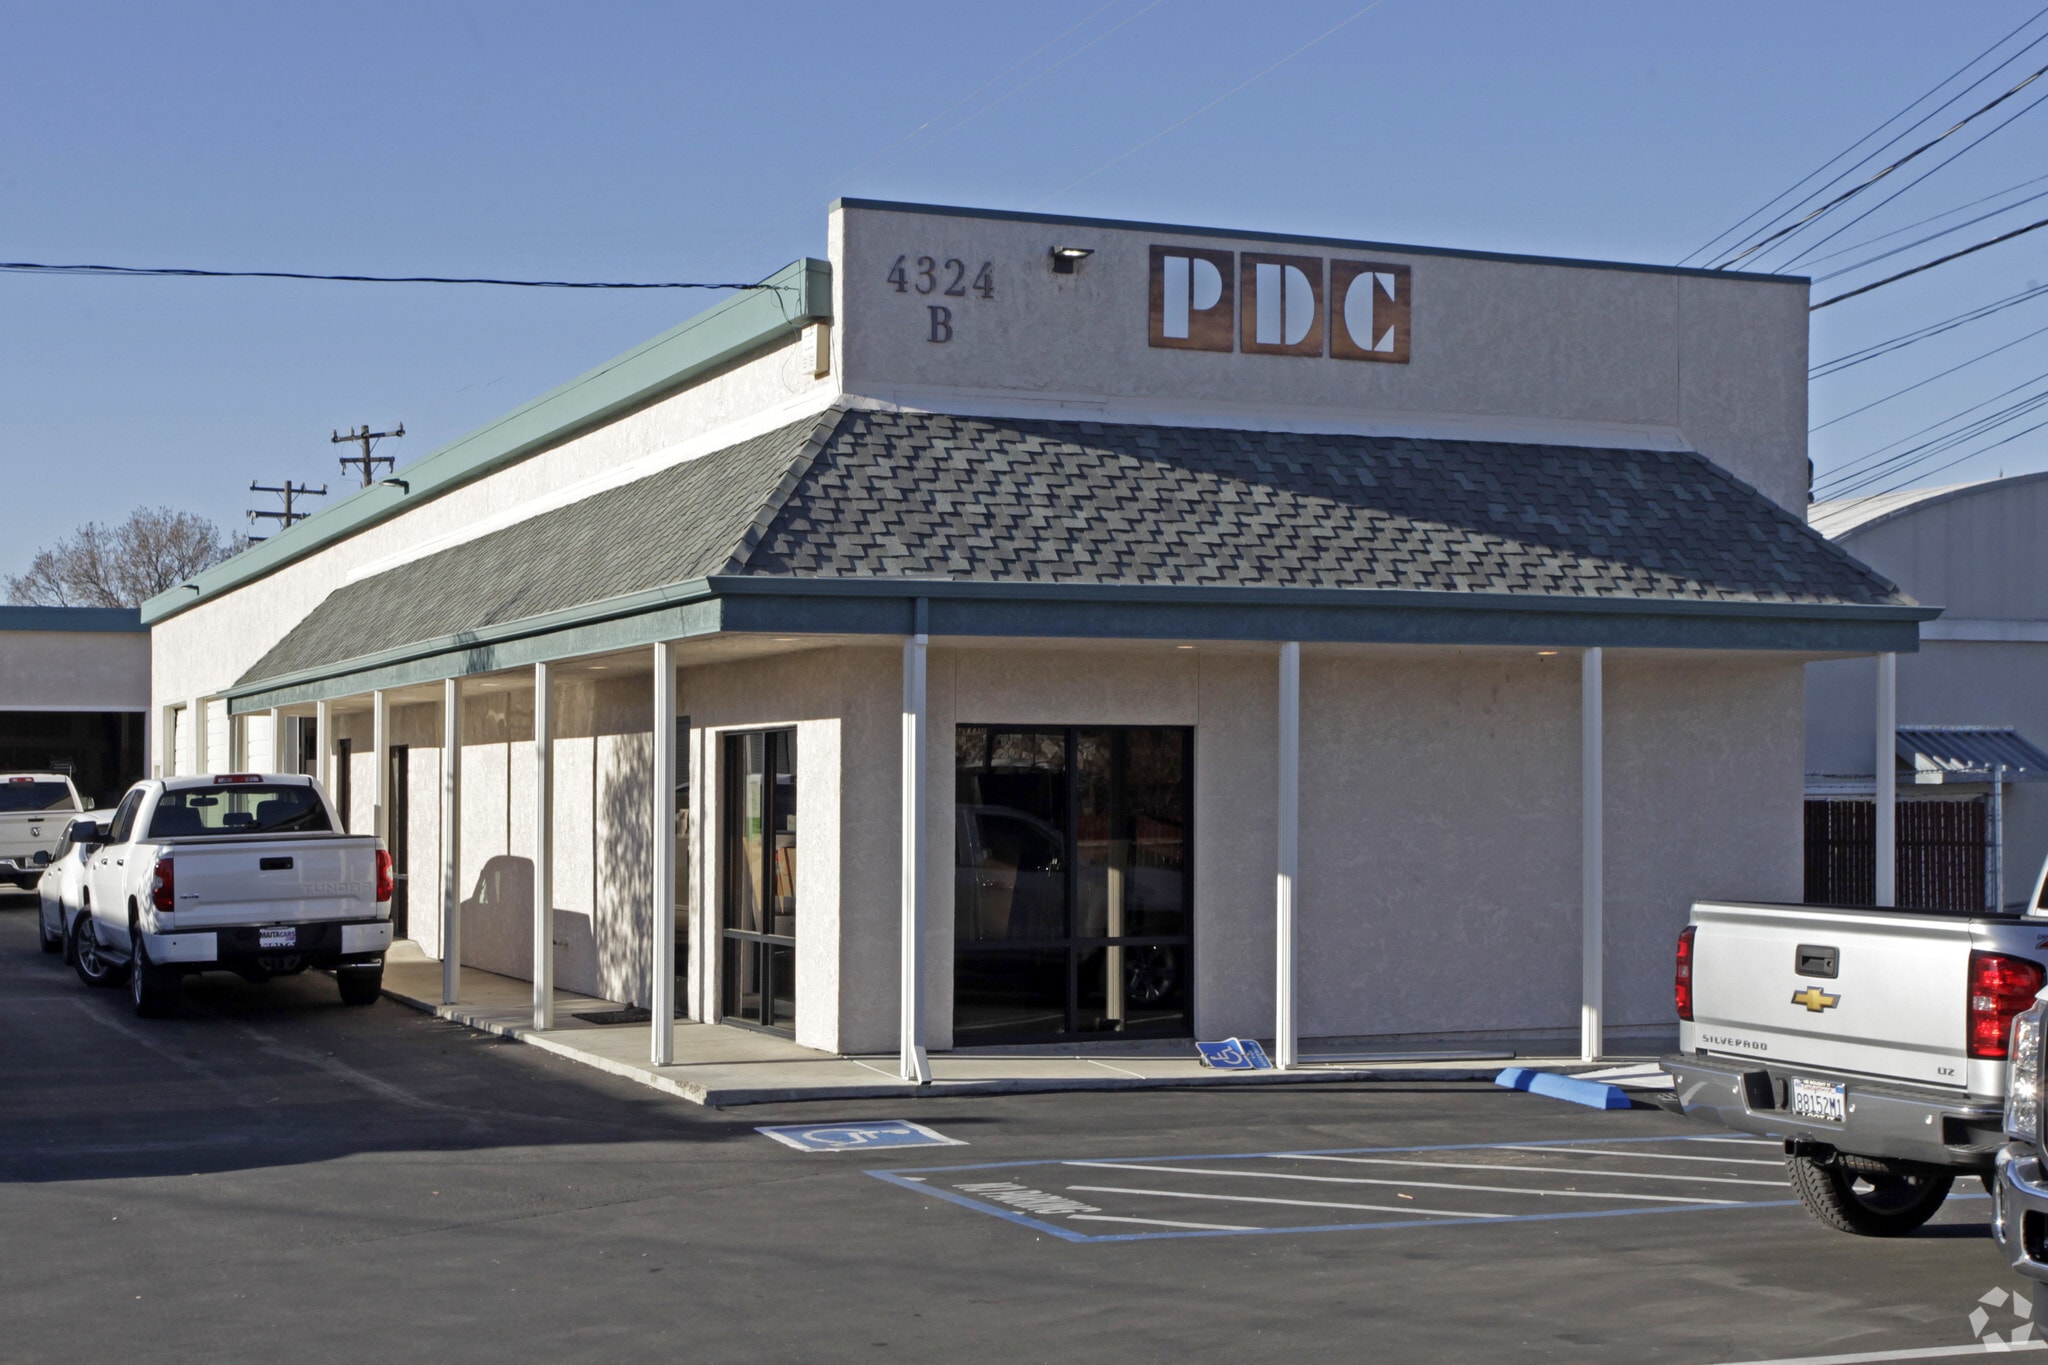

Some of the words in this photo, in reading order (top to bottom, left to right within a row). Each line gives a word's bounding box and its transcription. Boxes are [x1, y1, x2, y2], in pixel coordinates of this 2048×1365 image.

[887, 254, 995, 299] 4324
[1162, 254, 1395, 352] PDC
[927, 305, 954, 344] B
[1702, 1034, 1768, 1051] SILVERADO
